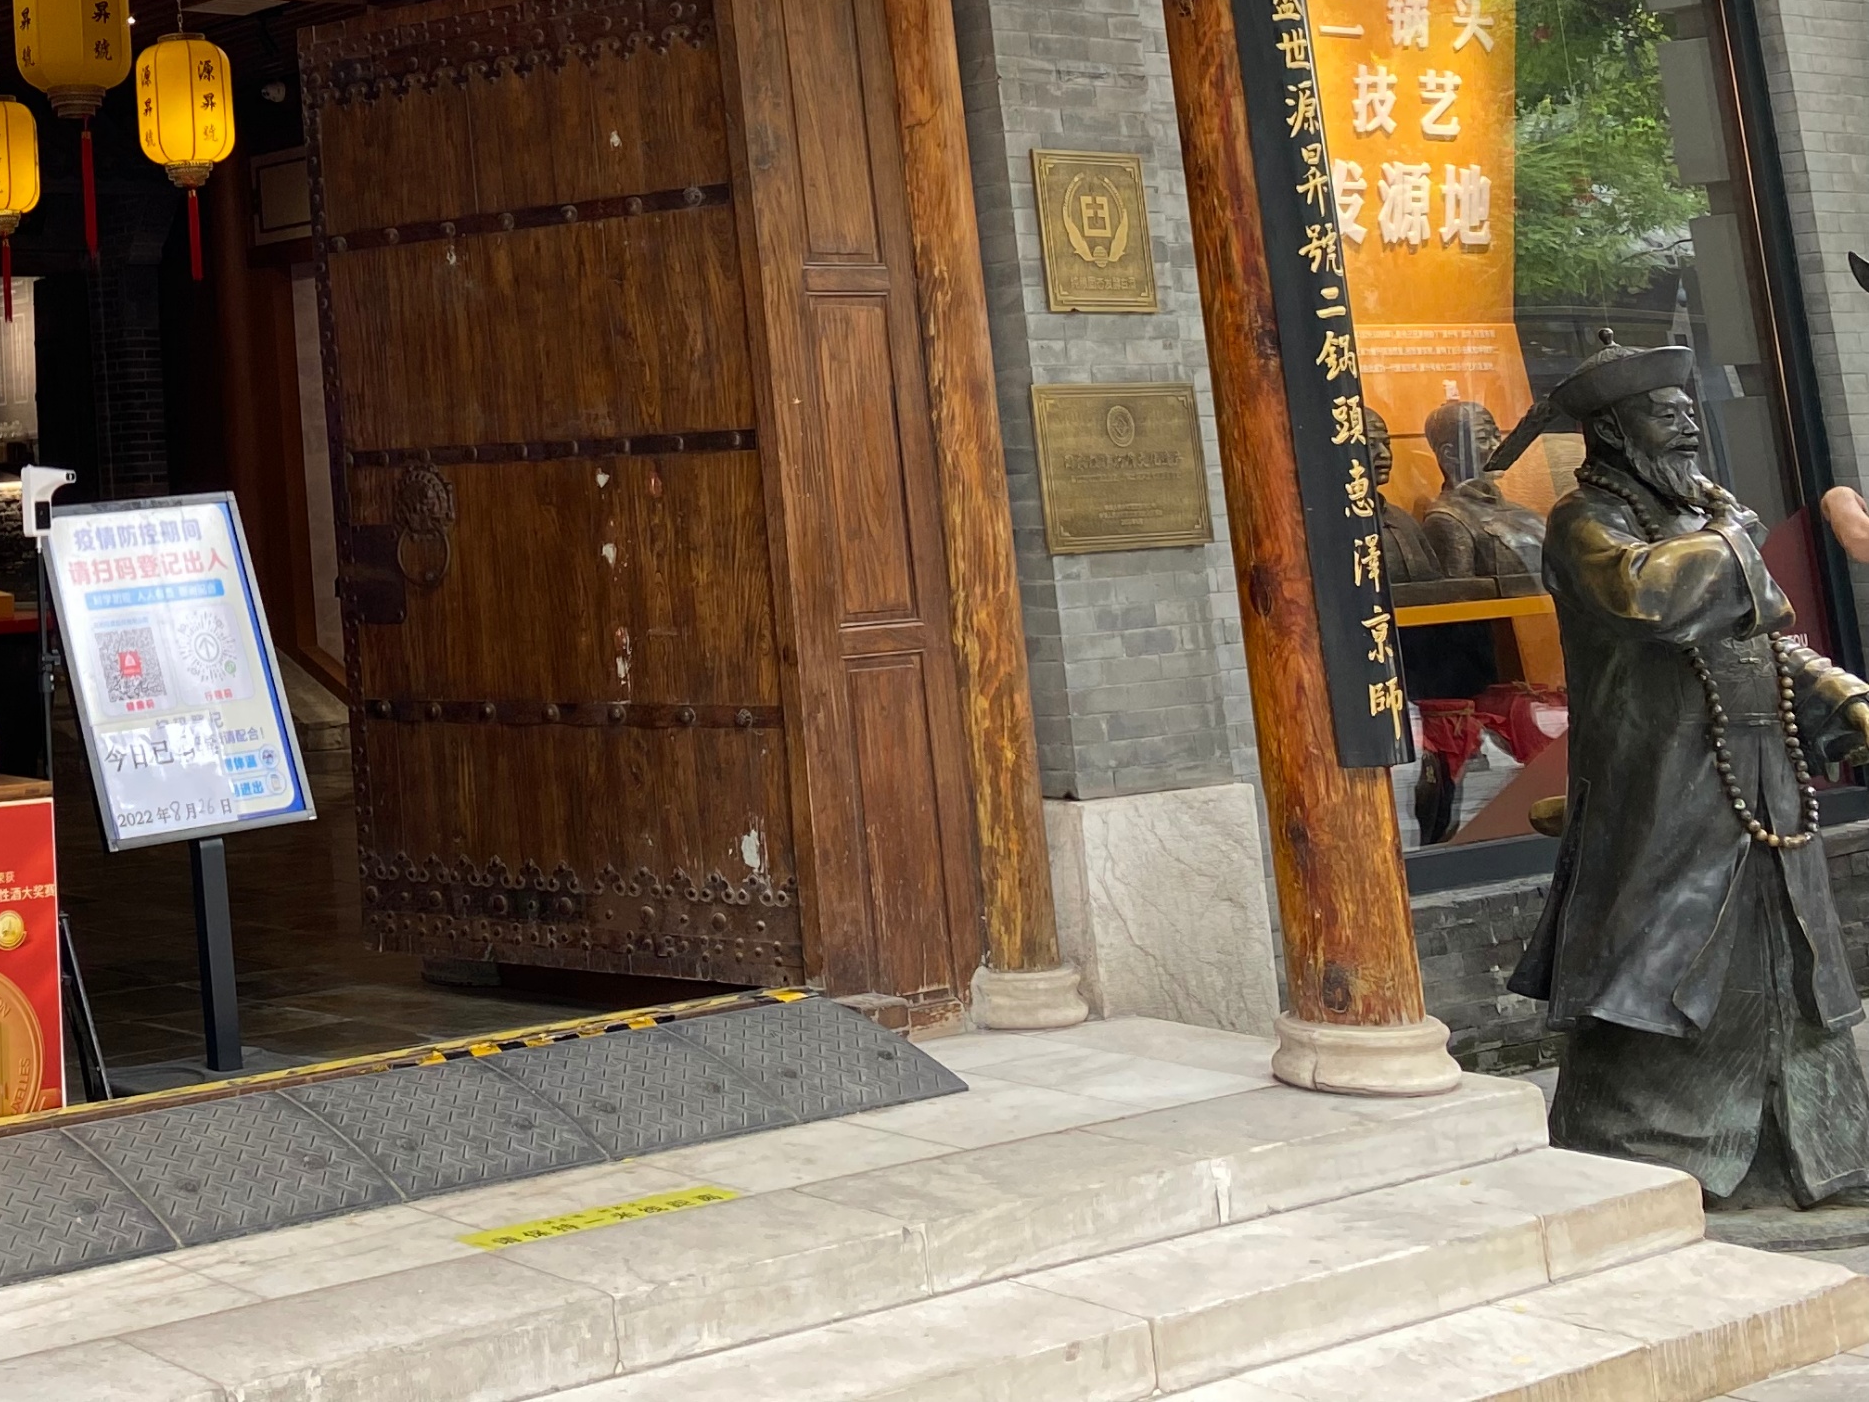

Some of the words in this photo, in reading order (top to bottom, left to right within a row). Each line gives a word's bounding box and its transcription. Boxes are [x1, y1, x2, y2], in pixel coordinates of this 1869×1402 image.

[1352, 64, 1463, 140] 技艺
[1332, 158, 1492, 250] 发源地
[74, 519, 202, 551] 疫情防控期间
